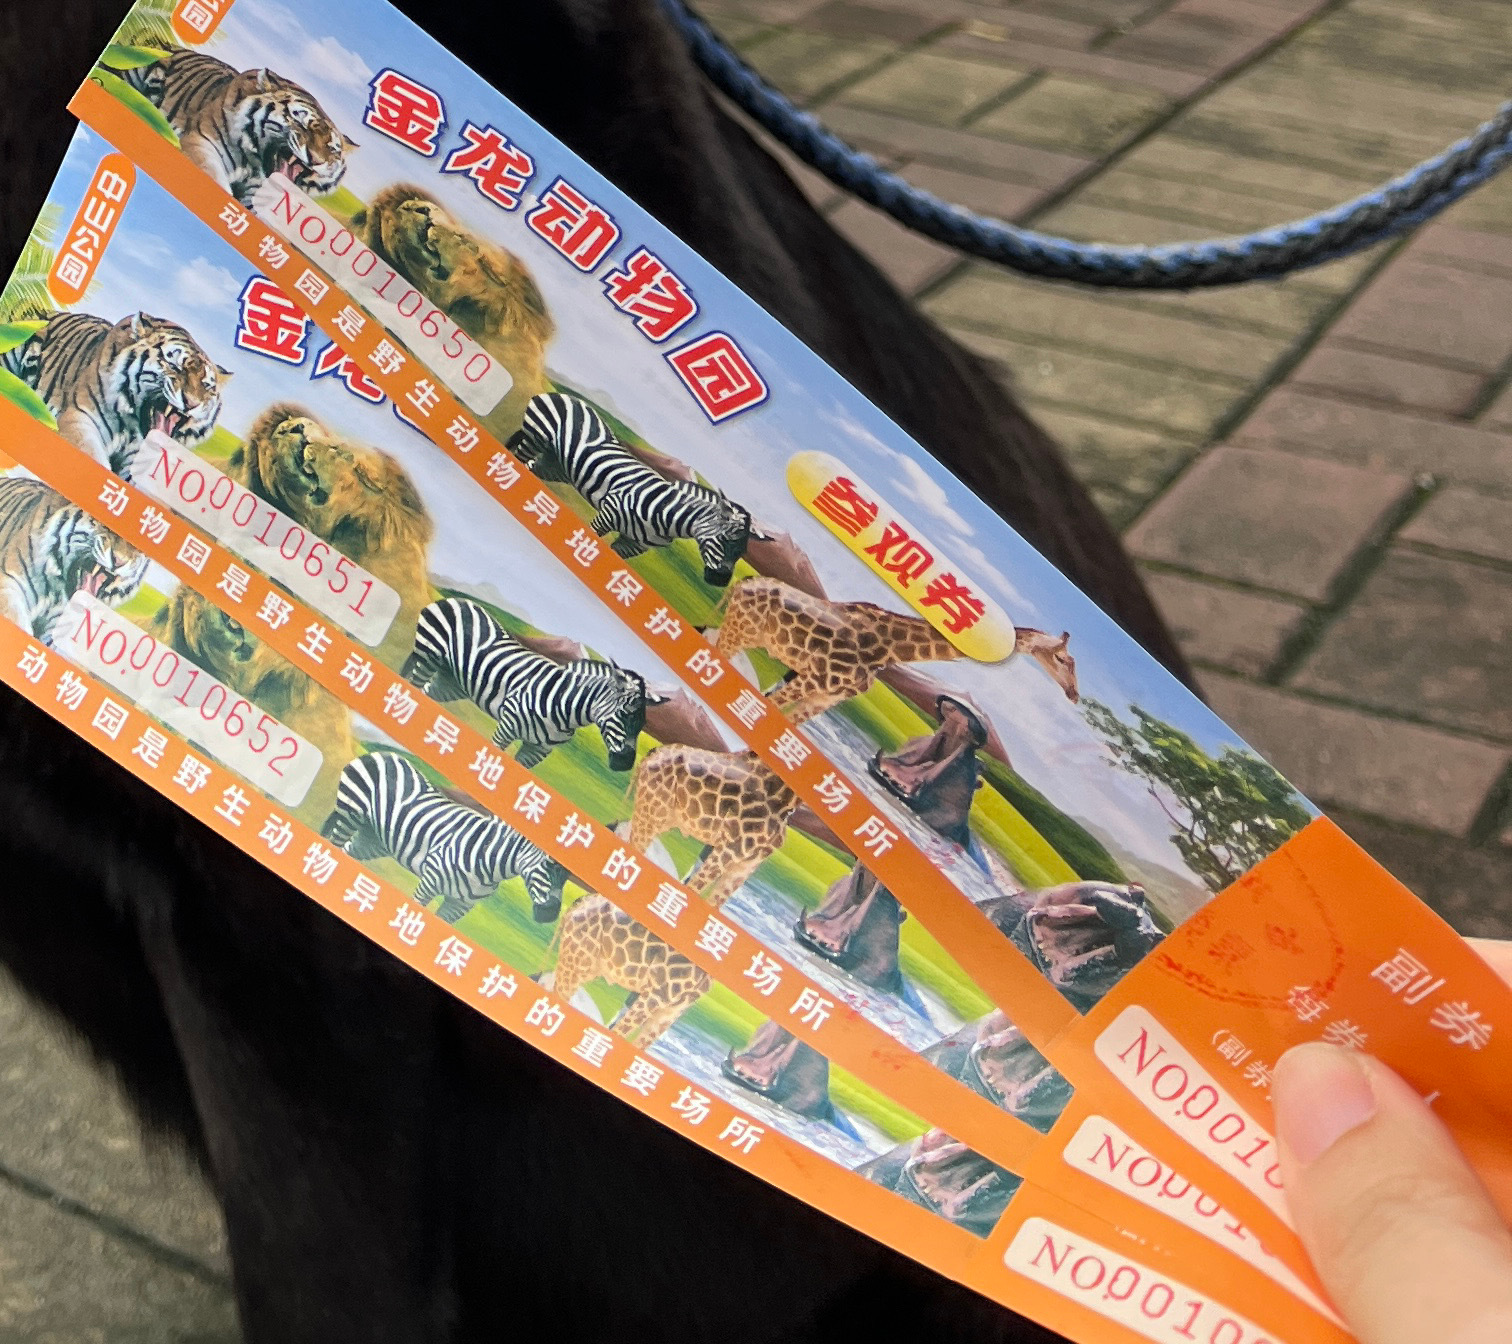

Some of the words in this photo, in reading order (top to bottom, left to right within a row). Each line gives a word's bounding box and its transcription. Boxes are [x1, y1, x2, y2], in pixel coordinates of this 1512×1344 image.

[56, 169, 127, 290] 中山公园
[271, 187, 492, 383] NO.0010650
[364, 67, 770, 425] 金龙动物园
[151, 446, 374, 620] NO.0010651
[219, 201, 899, 859] 动物园是野生动物异地保护的重要场所
[810, 475, 987, 638] 参观券
[71, 607, 303, 780] NO.0010652
[97, 477, 835, 1032] 动物园是野生动物异地保护的重要场所
[17, 645, 765, 1155] 动物园是野生动物异地保护的重要场所
[1370, 947, 1494, 1050] 副券
[1029, 1233, 1280, 1344] NO.0010
